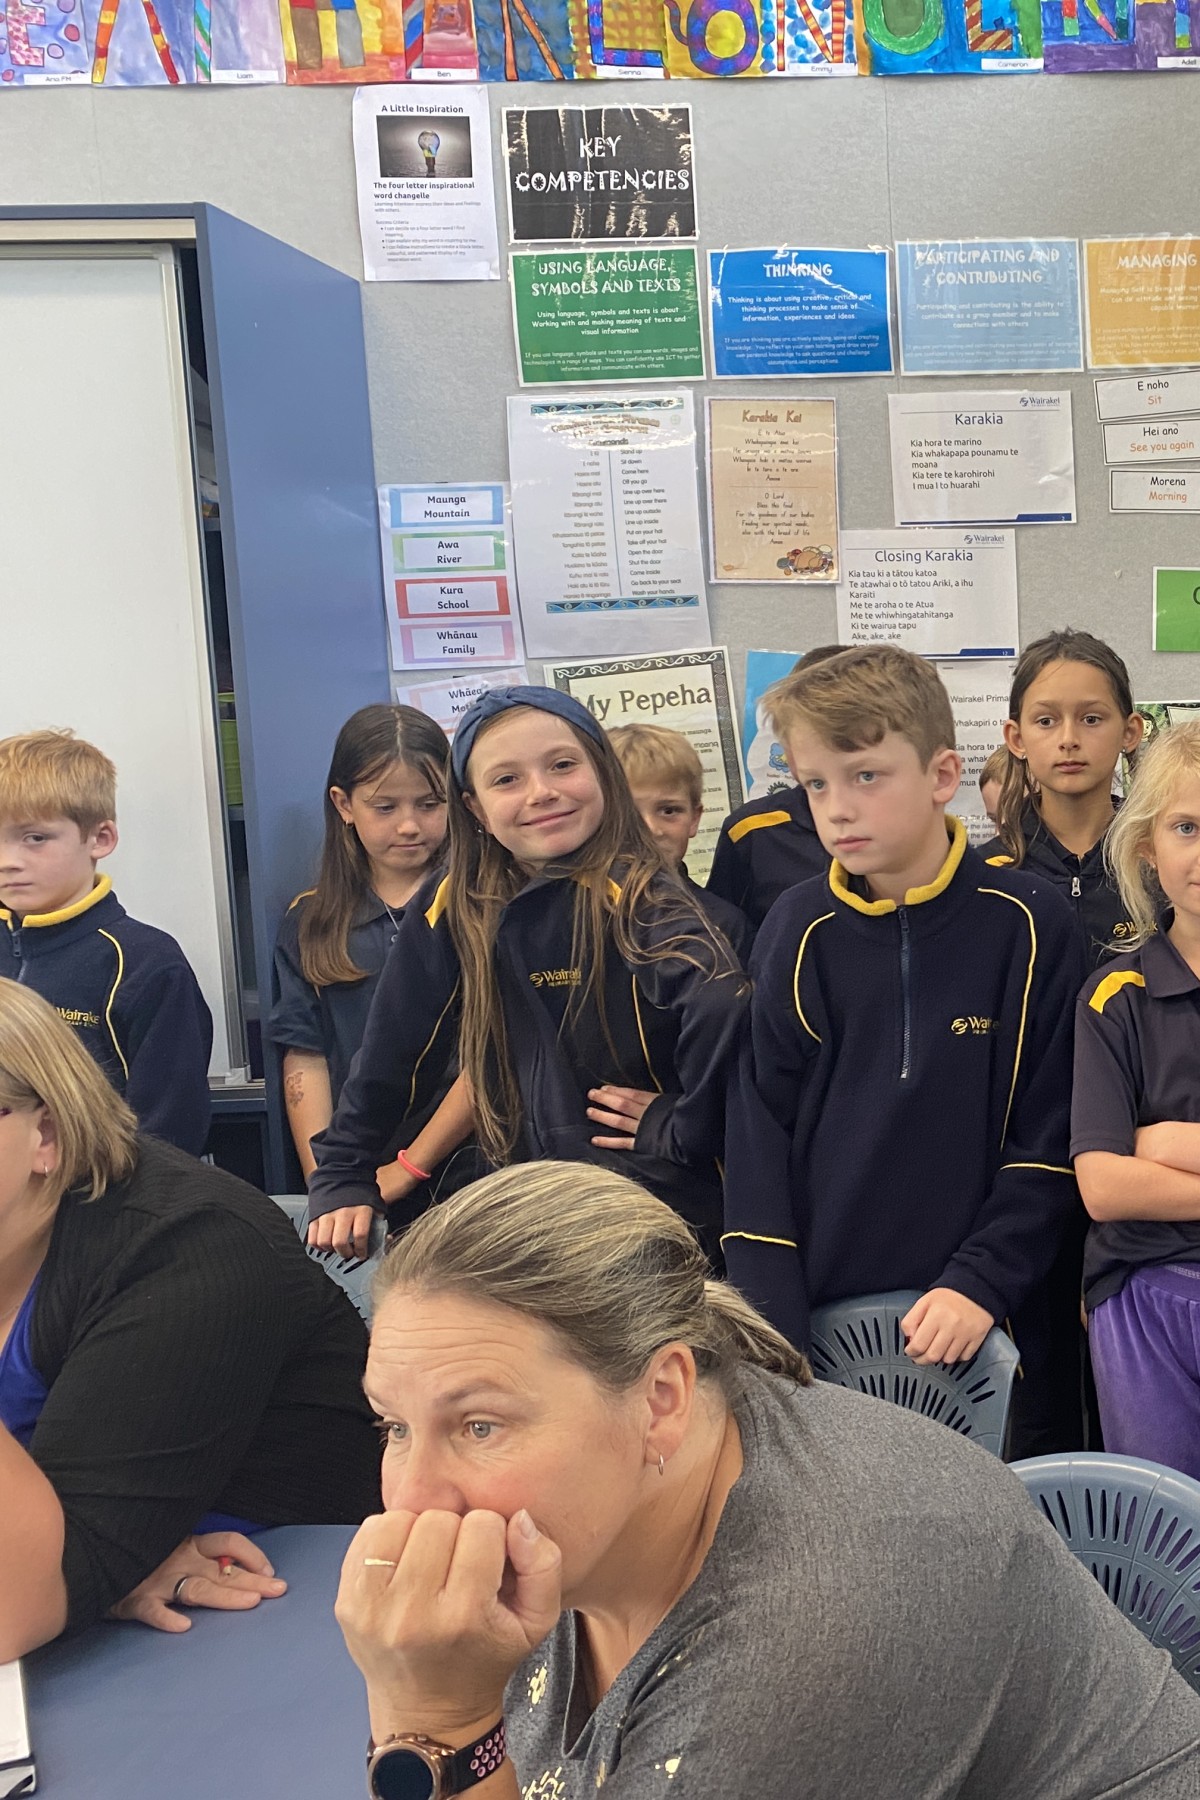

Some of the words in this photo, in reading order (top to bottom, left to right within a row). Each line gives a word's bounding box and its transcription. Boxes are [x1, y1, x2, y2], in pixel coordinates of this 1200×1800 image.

[810, 65, 833, 73] Emmy
[997, 60, 1029, 69] Cameron
[236, 72, 254, 80] Liam
[390, 104, 414, 113] Little
[416, 105, 464, 114] Inspiration
[579, 135, 622, 158] KEY
[514, 168, 690, 193] COMPETENCIES
[429, 182, 475, 190] inspirational
[915, 249, 1026, 265] PARTICIPATING
[1028, 248, 1060, 263] AND
[1116, 253, 1197, 270] MANAGING
[538, 261, 582, 275] USING
[763, 262, 833, 278] THINKING
[936, 270, 1043, 285] CONTRIBUTING
[531, 281, 598, 296] SYMBOLS
[601, 279, 634, 293] AND
[636, 278, 681, 292] TEXTS
[1137, 382, 1144, 391] E
[1147, 380, 1169, 390] noho
[1029, 397, 1060, 405] Wairakei
[1147, 395, 1162, 404] Sit
[955, 413, 1003, 425] Karakia
[1143, 427, 1160, 436] Hei
[924, 439, 942, 447] hora
[1130, 442, 1148, 452] See
[1150, 442, 1167, 453] you
[1169, 440, 1195, 451] again
[925, 449, 969, 458] whakapapa
[971, 449, 1009, 458] pounamu
[954, 470, 995, 478] karohirohi
[950, 481, 980, 489] huarahi
[1150, 476, 1186, 486] Morena
[427, 496, 466, 505] Maunga
[1149, 491, 1187, 503] Morning
[424, 510, 470, 518] Mountain
[437, 555, 462, 564] River
[875, 550, 922, 564] Closing
[925, 550, 973, 562] Karakia
[860, 580, 891, 588] atawhai
[933, 579, 953, 588] Ariki,
[440, 587, 464, 595] Kura
[437, 600, 469, 609] School
[875, 611, 954, 620] whiwhingatahitanga
[898, 622, 917, 630] tapu
[436, 631, 478, 640] Whānau
[442, 645, 475, 655] Family
[619, 684, 712, 715] Pepeha
